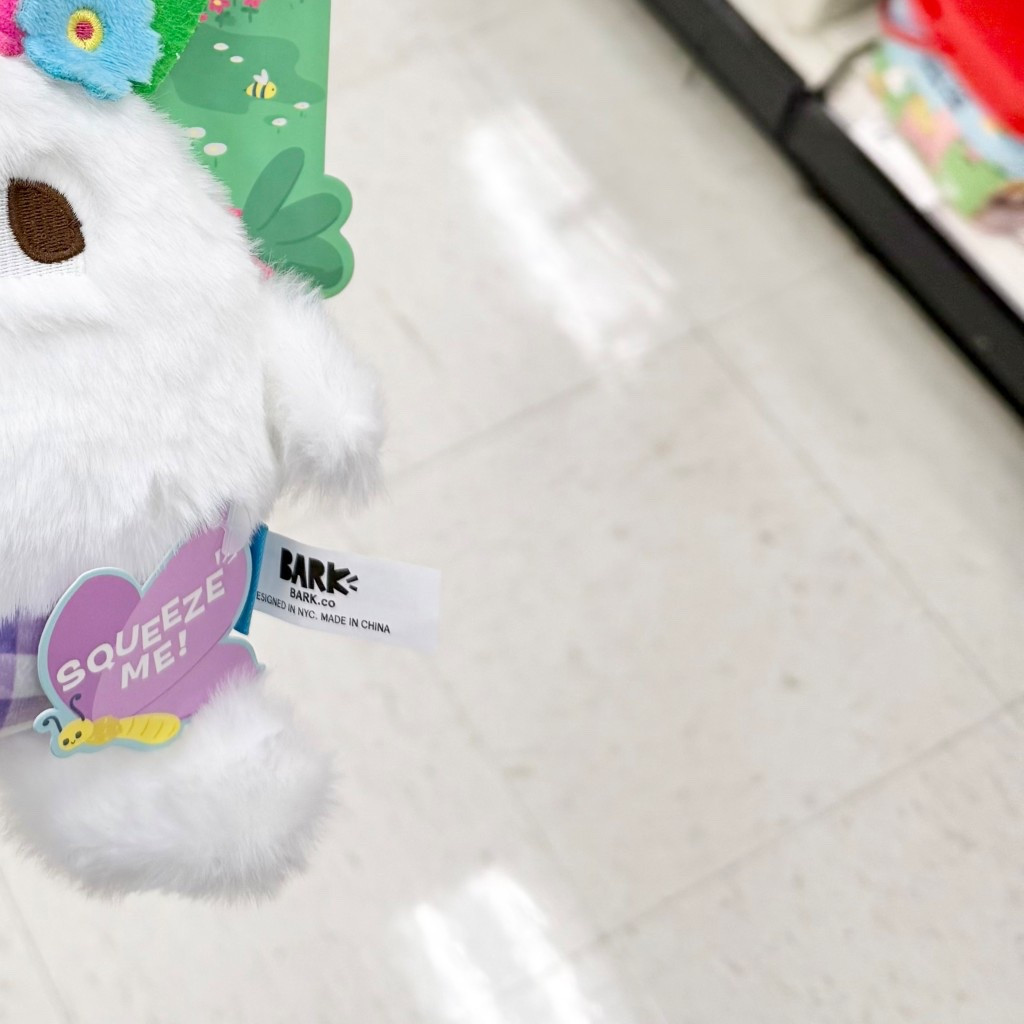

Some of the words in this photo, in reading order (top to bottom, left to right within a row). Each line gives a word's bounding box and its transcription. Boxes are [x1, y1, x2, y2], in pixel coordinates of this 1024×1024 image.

[279, 547, 351, 596] BARK
[56, 568, 226, 693] SQUEEZE
[255, 590, 287, 610] ESIGNED
[287, 603, 296, 614] IN
[320, 612, 346, 626] MADE
[348, 617, 359, 628] IN
[360, 619, 391, 634] CHINA
[120, 629, 188, 690] ME!
